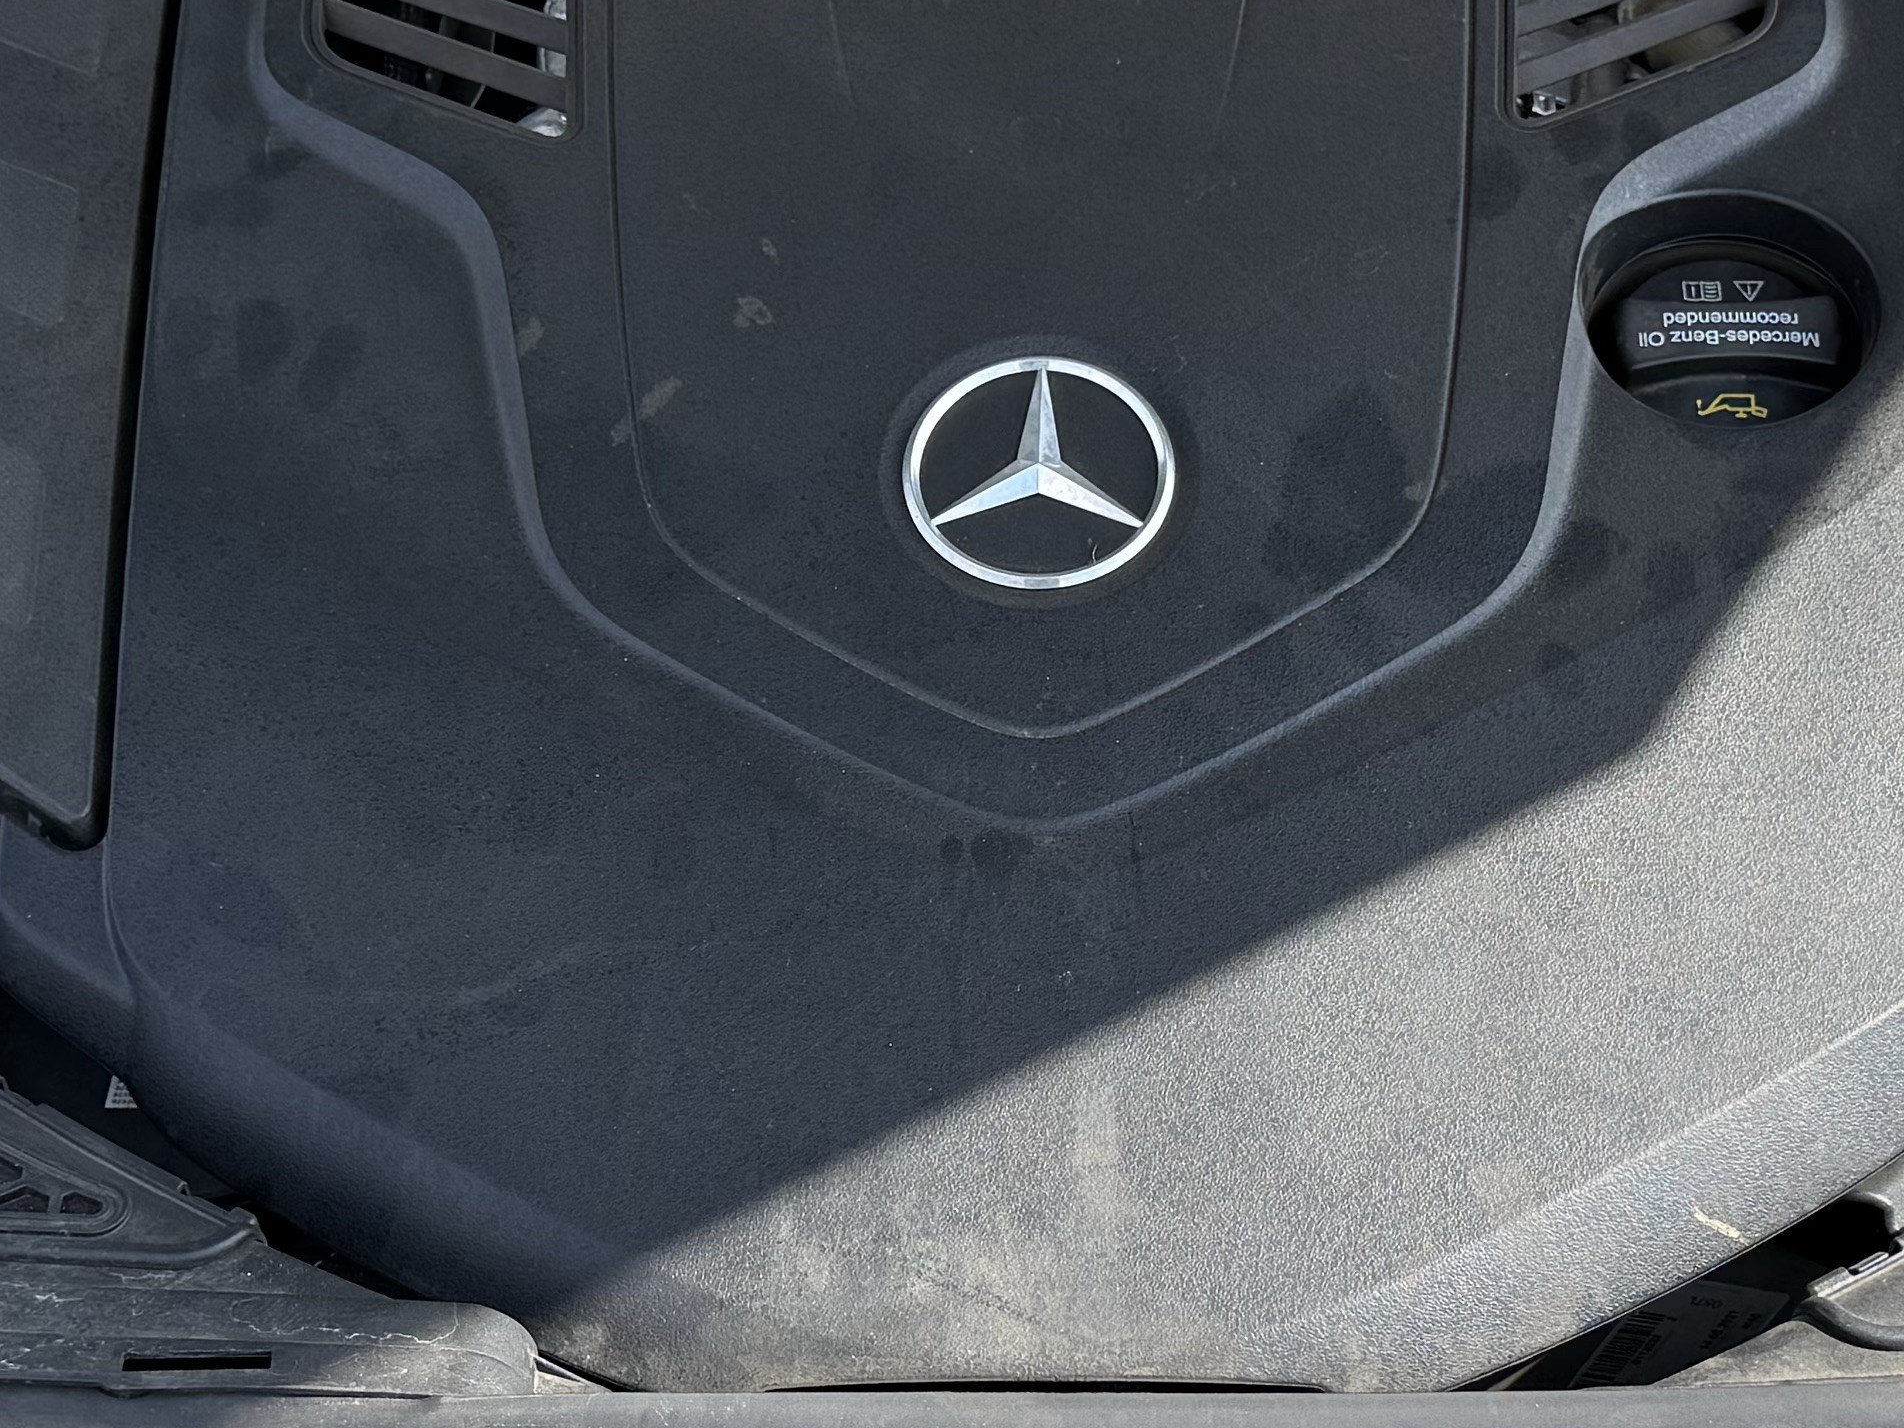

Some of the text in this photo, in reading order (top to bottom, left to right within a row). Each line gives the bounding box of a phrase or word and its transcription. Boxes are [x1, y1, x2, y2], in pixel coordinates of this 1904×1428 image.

[1663, 311, 1799, 327] recommended
[1638, 329, 1820, 348] Mercedes-Benz Oil
